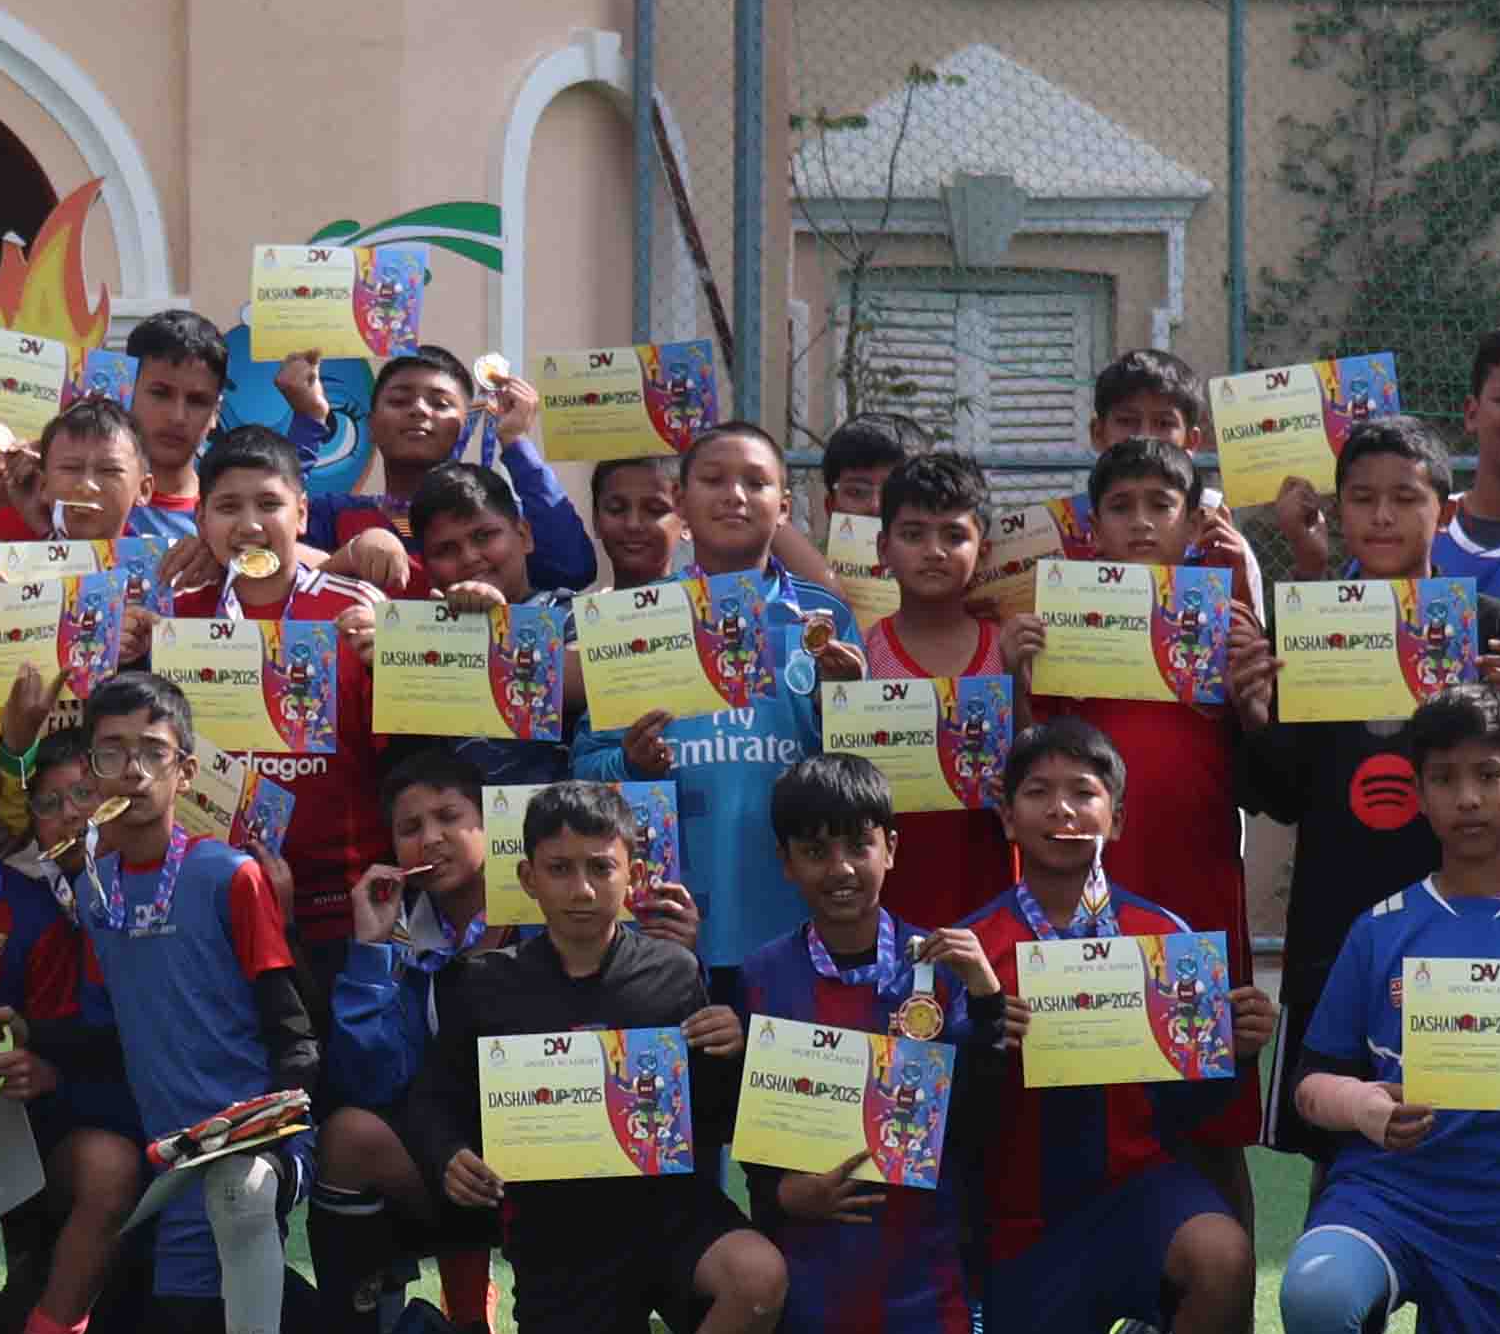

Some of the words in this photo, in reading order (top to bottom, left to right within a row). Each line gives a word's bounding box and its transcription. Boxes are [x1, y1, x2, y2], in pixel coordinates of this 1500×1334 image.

[308, 249, 332, 263] DAV
[19, 338, 45, 356] DAV
[589, 353, 614, 367] DAV
[1265, 372, 1290, 389] DAV
[6, 378, 59, 403] UP-2025
[544, 393, 586, 407] DASHAIN
[1222, 422, 1264, 443] DASHAIN
[1264, 413, 1321, 432] UP-2025
[1001, 513, 1024, 534] DAV
[48, 545, 70, 562] DAV
[1098, 567, 1125, 583] DAV
[21, 584, 42, 601] DAV
[634, 590, 659, 609] DAV
[1337, 585, 1365, 603] DAV
[1042, 611, 1088, 628] DASHAIN
[1088, 611, 1148, 631] UP-2025
[210, 623, 235, 639] DAV
[587, 642, 634, 662] DASHAIN
[634, 634, 693, 655] UP-2025
[1284, 634, 1331, 651] DASHAIN
[1331, 632, 1394, 650] UP-2025
[381, 650, 426, 666] DASHAIN
[426, 650, 486, 668] UP-2025
[203, 666, 259, 685] UP-2025
[882, 685, 908, 701] DAV
[831, 732, 876, 748] DASHAIN
[876, 730, 934, 746] UP-2025
[492, 840, 524, 855] DASH
[1083, 942, 1111, 961] DAV
[1472, 964, 1500, 982] DAV
[1028, 997, 1078, 1012] DASHAIN
[1078, 992, 1143, 1010] UP-2025
[1411, 1015, 1460, 1033] DASHAIN
[544, 1037, 571, 1056] DAV
[813, 1030, 841, 1049] DAV
[750, 1071, 798, 1095] DASHAIN
[798, 1078, 861, 1104] UP-2025
[488, 1090, 537, 1107] DASHAIN
[537, 1087, 602, 1105] UP-2025
